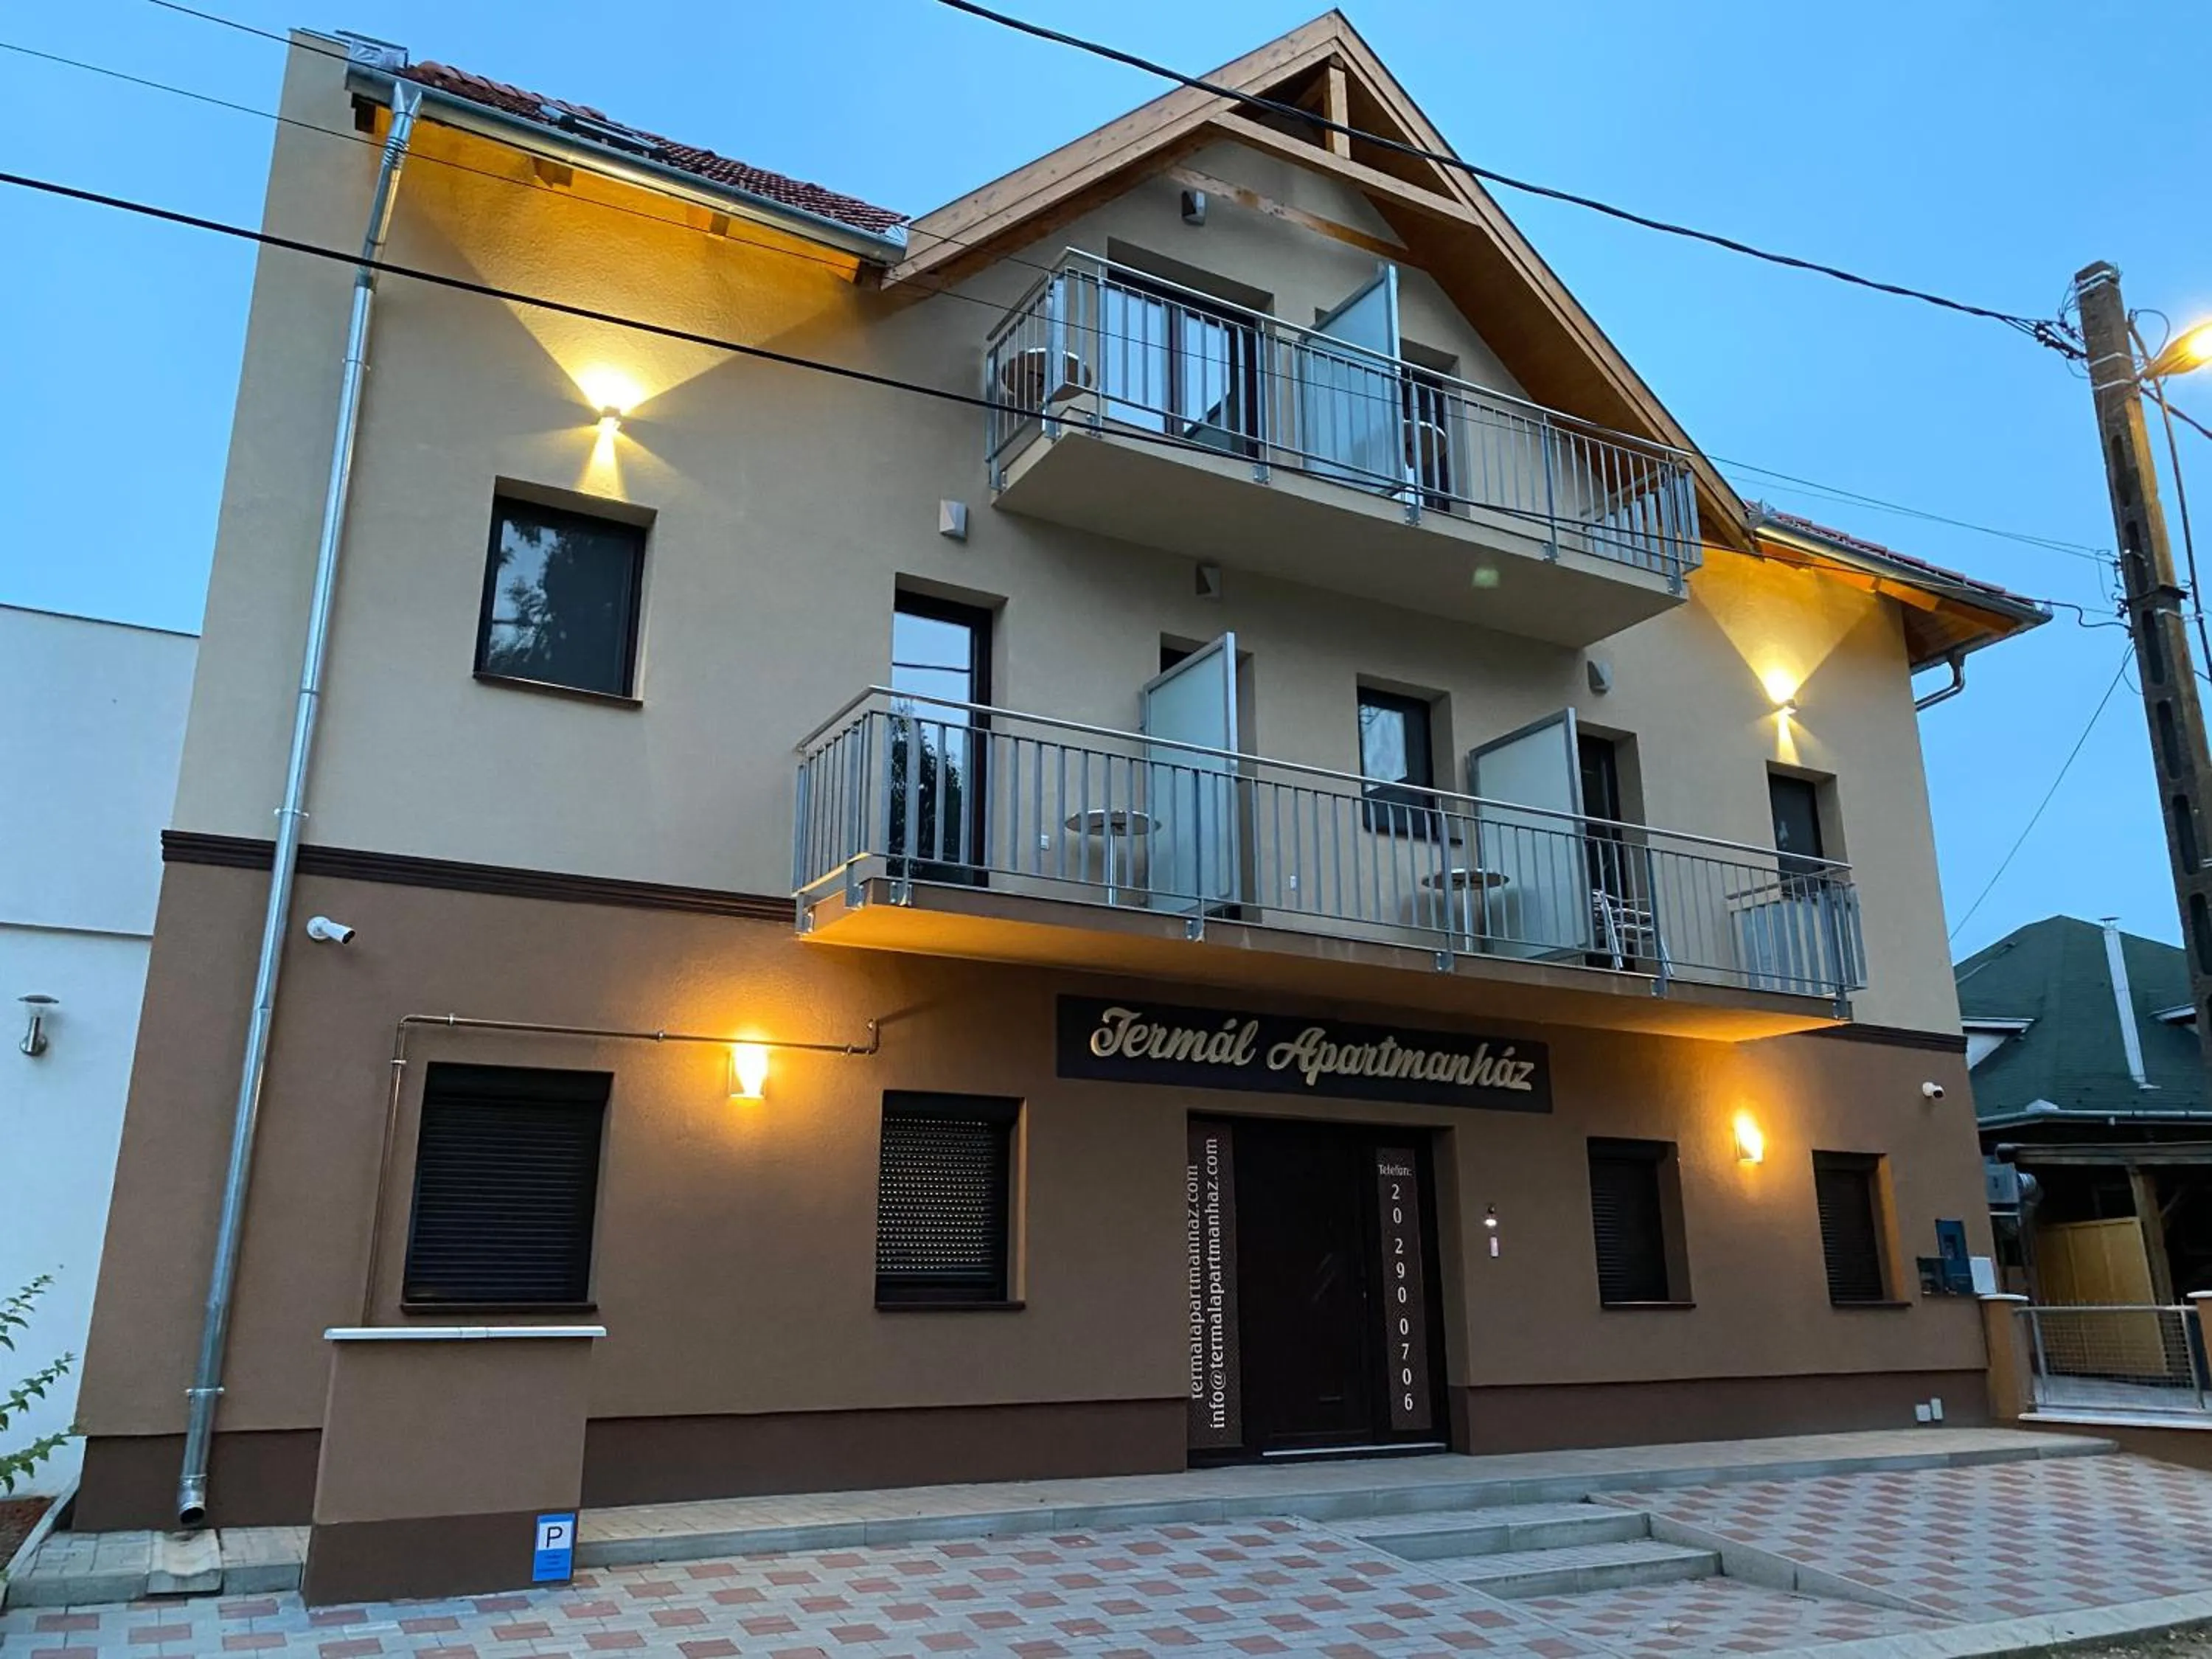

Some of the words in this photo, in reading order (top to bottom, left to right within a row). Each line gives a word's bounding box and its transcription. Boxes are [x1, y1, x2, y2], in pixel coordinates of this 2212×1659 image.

[1091, 1007, 1258, 1066] Termál
[1267, 1027, 1534, 1091] Apartmanház
[1204, 1138, 1225, 1429] info@termalapartmanhaz.com
[546, 1526, 563, 1548] P
